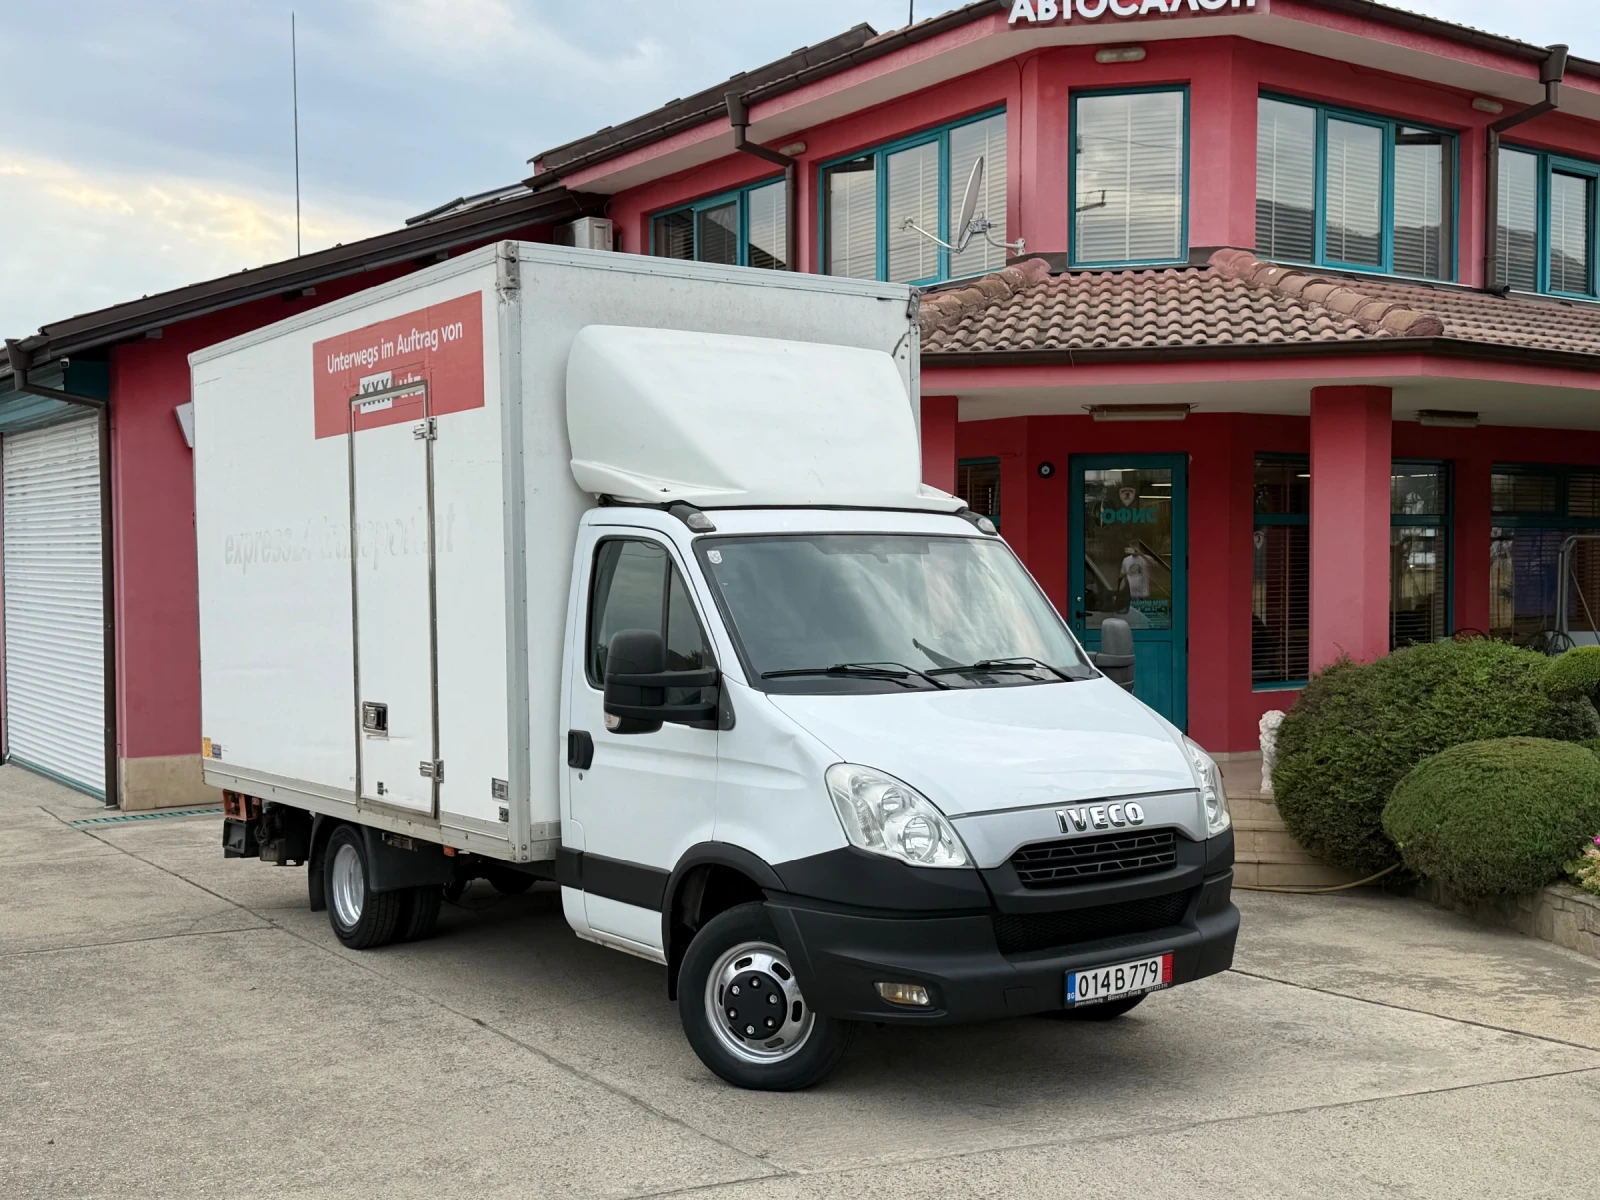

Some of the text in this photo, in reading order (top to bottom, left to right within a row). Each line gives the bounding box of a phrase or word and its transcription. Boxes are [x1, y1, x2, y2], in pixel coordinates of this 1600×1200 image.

[327, 321, 463, 374] Unterwegs im Auftrag von
[1102, 507, 1157, 524] ОФИС
[1055, 801, 1145, 834] IVECO
[1067, 992, 1075, 1000] BG
